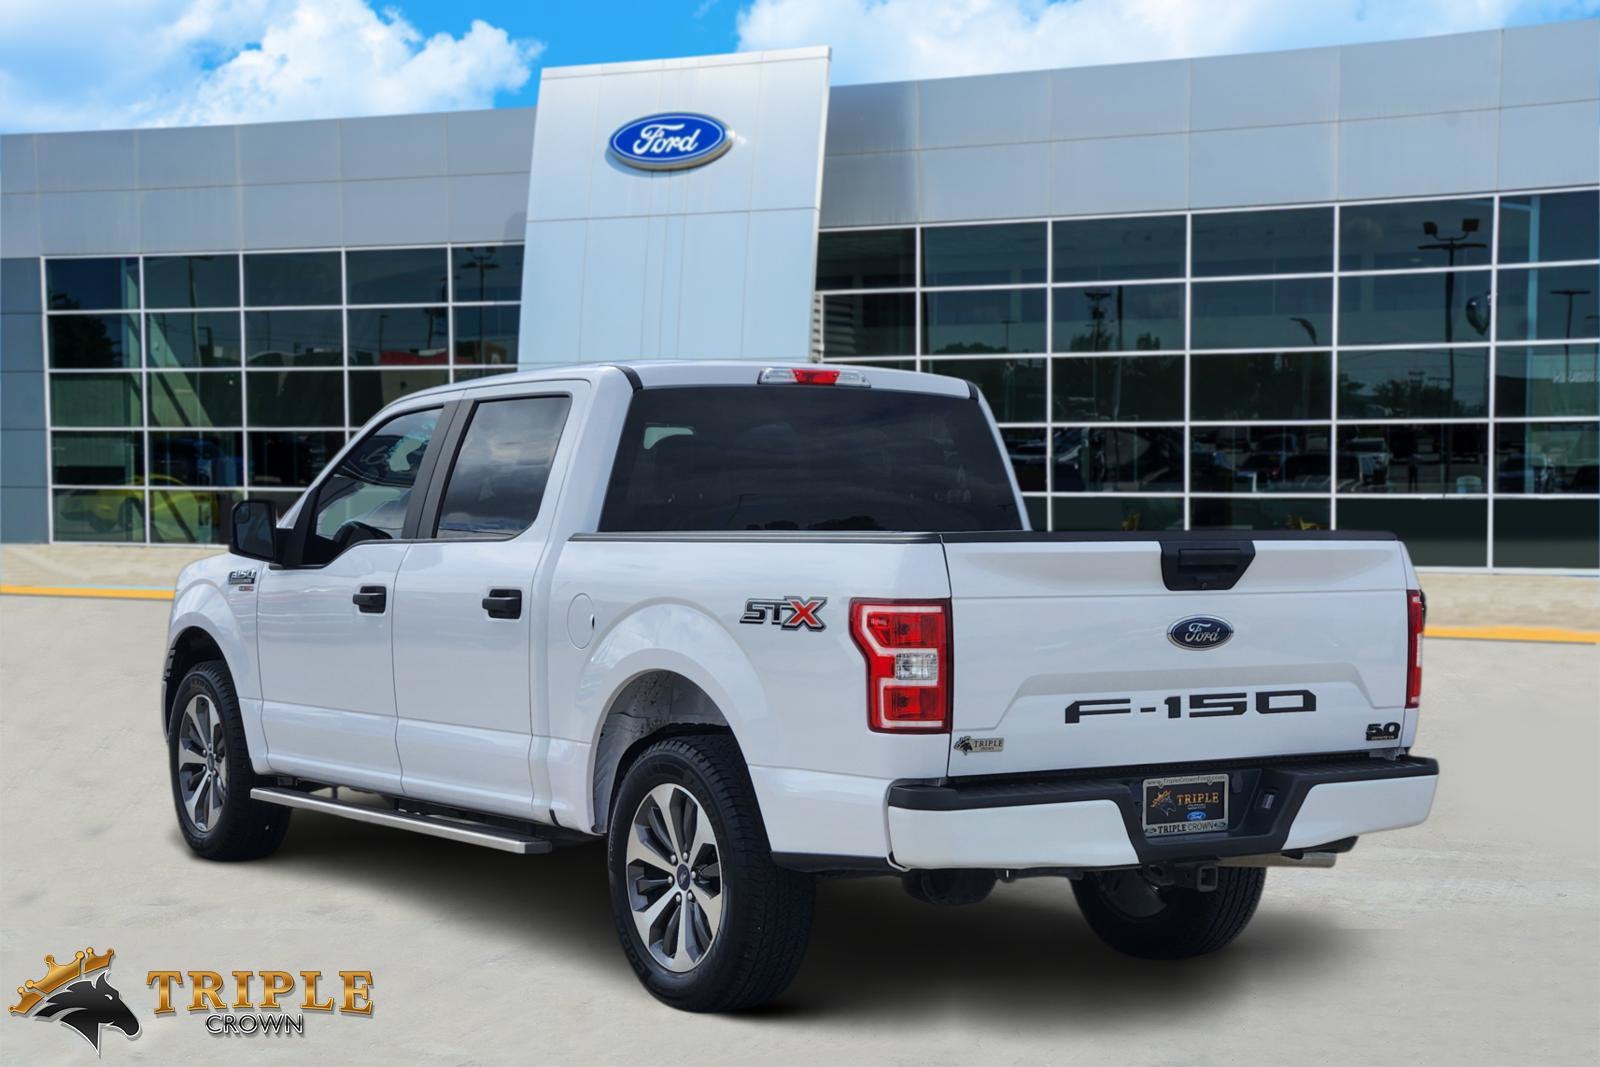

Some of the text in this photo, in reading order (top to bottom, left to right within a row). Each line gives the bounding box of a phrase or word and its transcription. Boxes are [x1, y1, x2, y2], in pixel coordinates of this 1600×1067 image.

[632, 123, 702, 155] Ford
[739, 595, 828, 632] STX
[1184, 622, 1221, 642] Ford
[1064, 689, 1317, 724] F-150
[1177, 792, 1219, 805] TRIPLE
